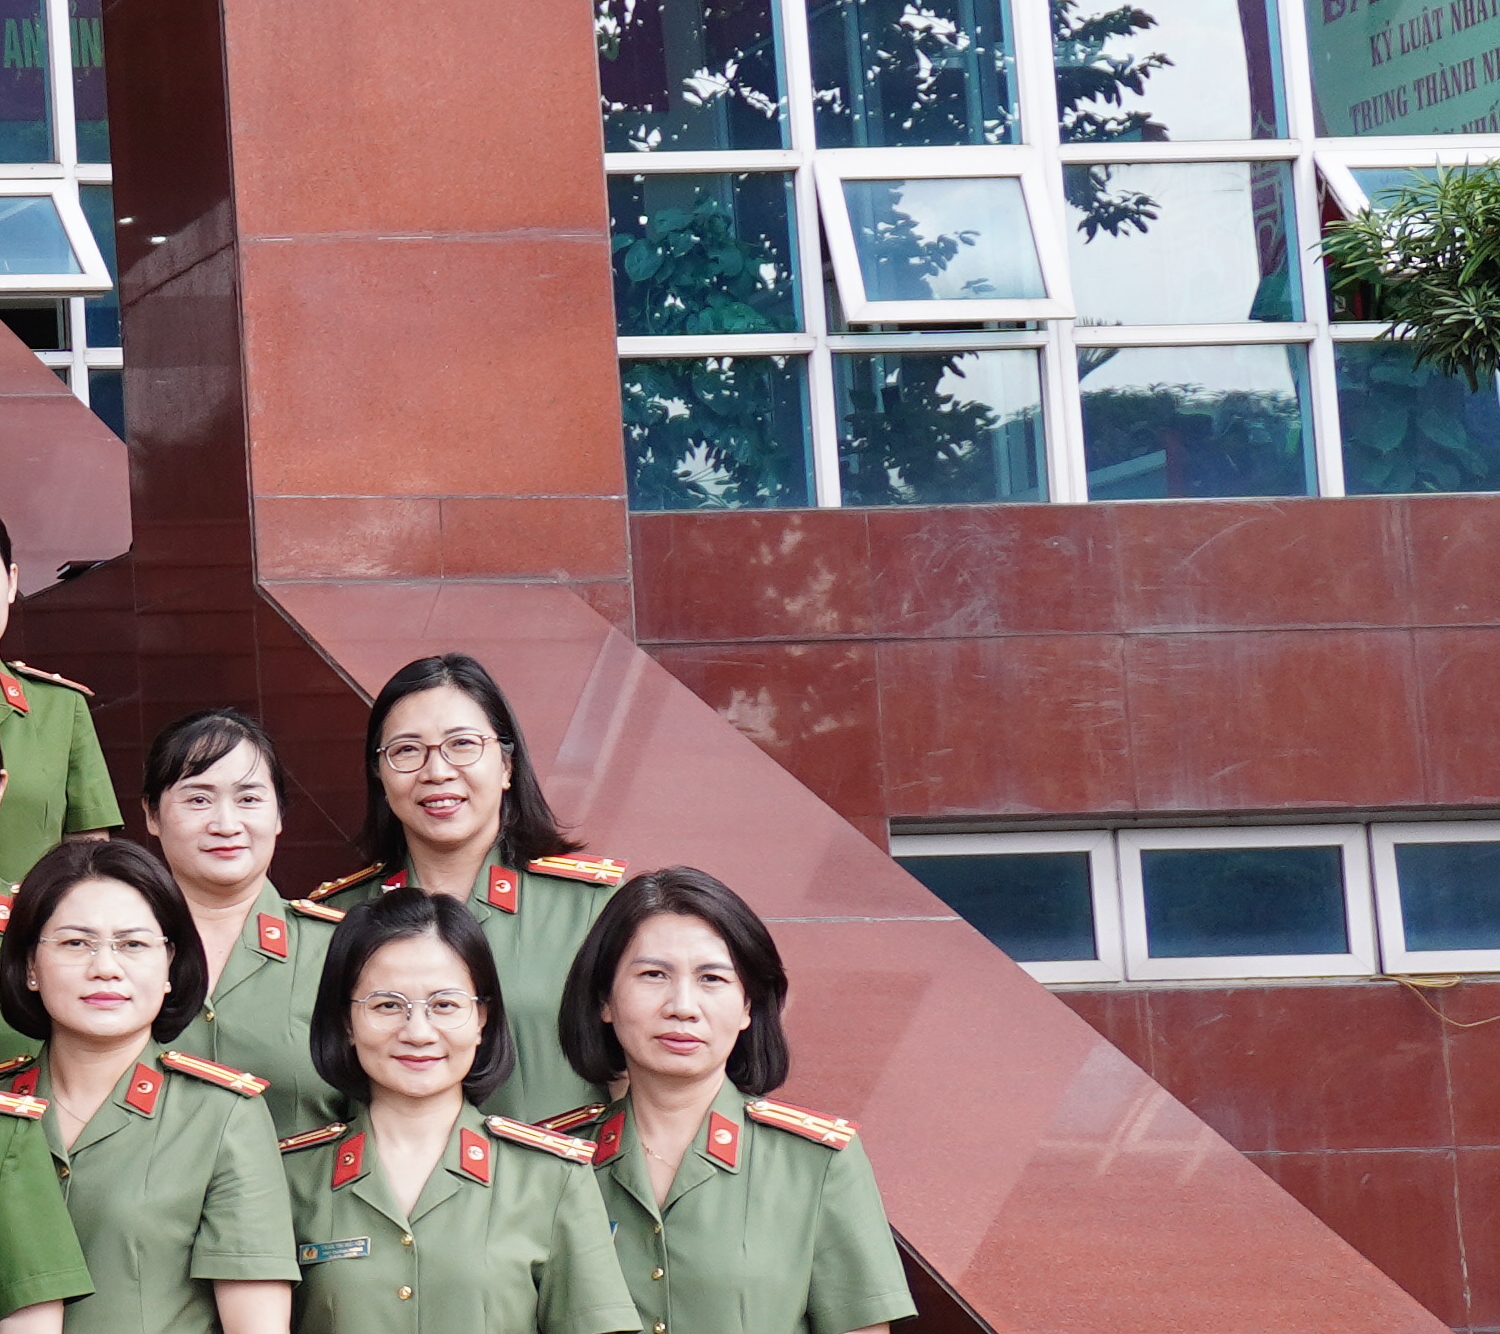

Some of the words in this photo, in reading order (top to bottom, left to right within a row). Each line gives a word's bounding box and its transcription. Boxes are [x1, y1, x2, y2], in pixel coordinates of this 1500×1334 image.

[1368, 19, 1394, 67] KỶ
[1398, 5, 1444, 55] LUẬT
[1349, 84, 1409, 136] TRUNG
[1413, 58, 1477, 111] THÀNH
